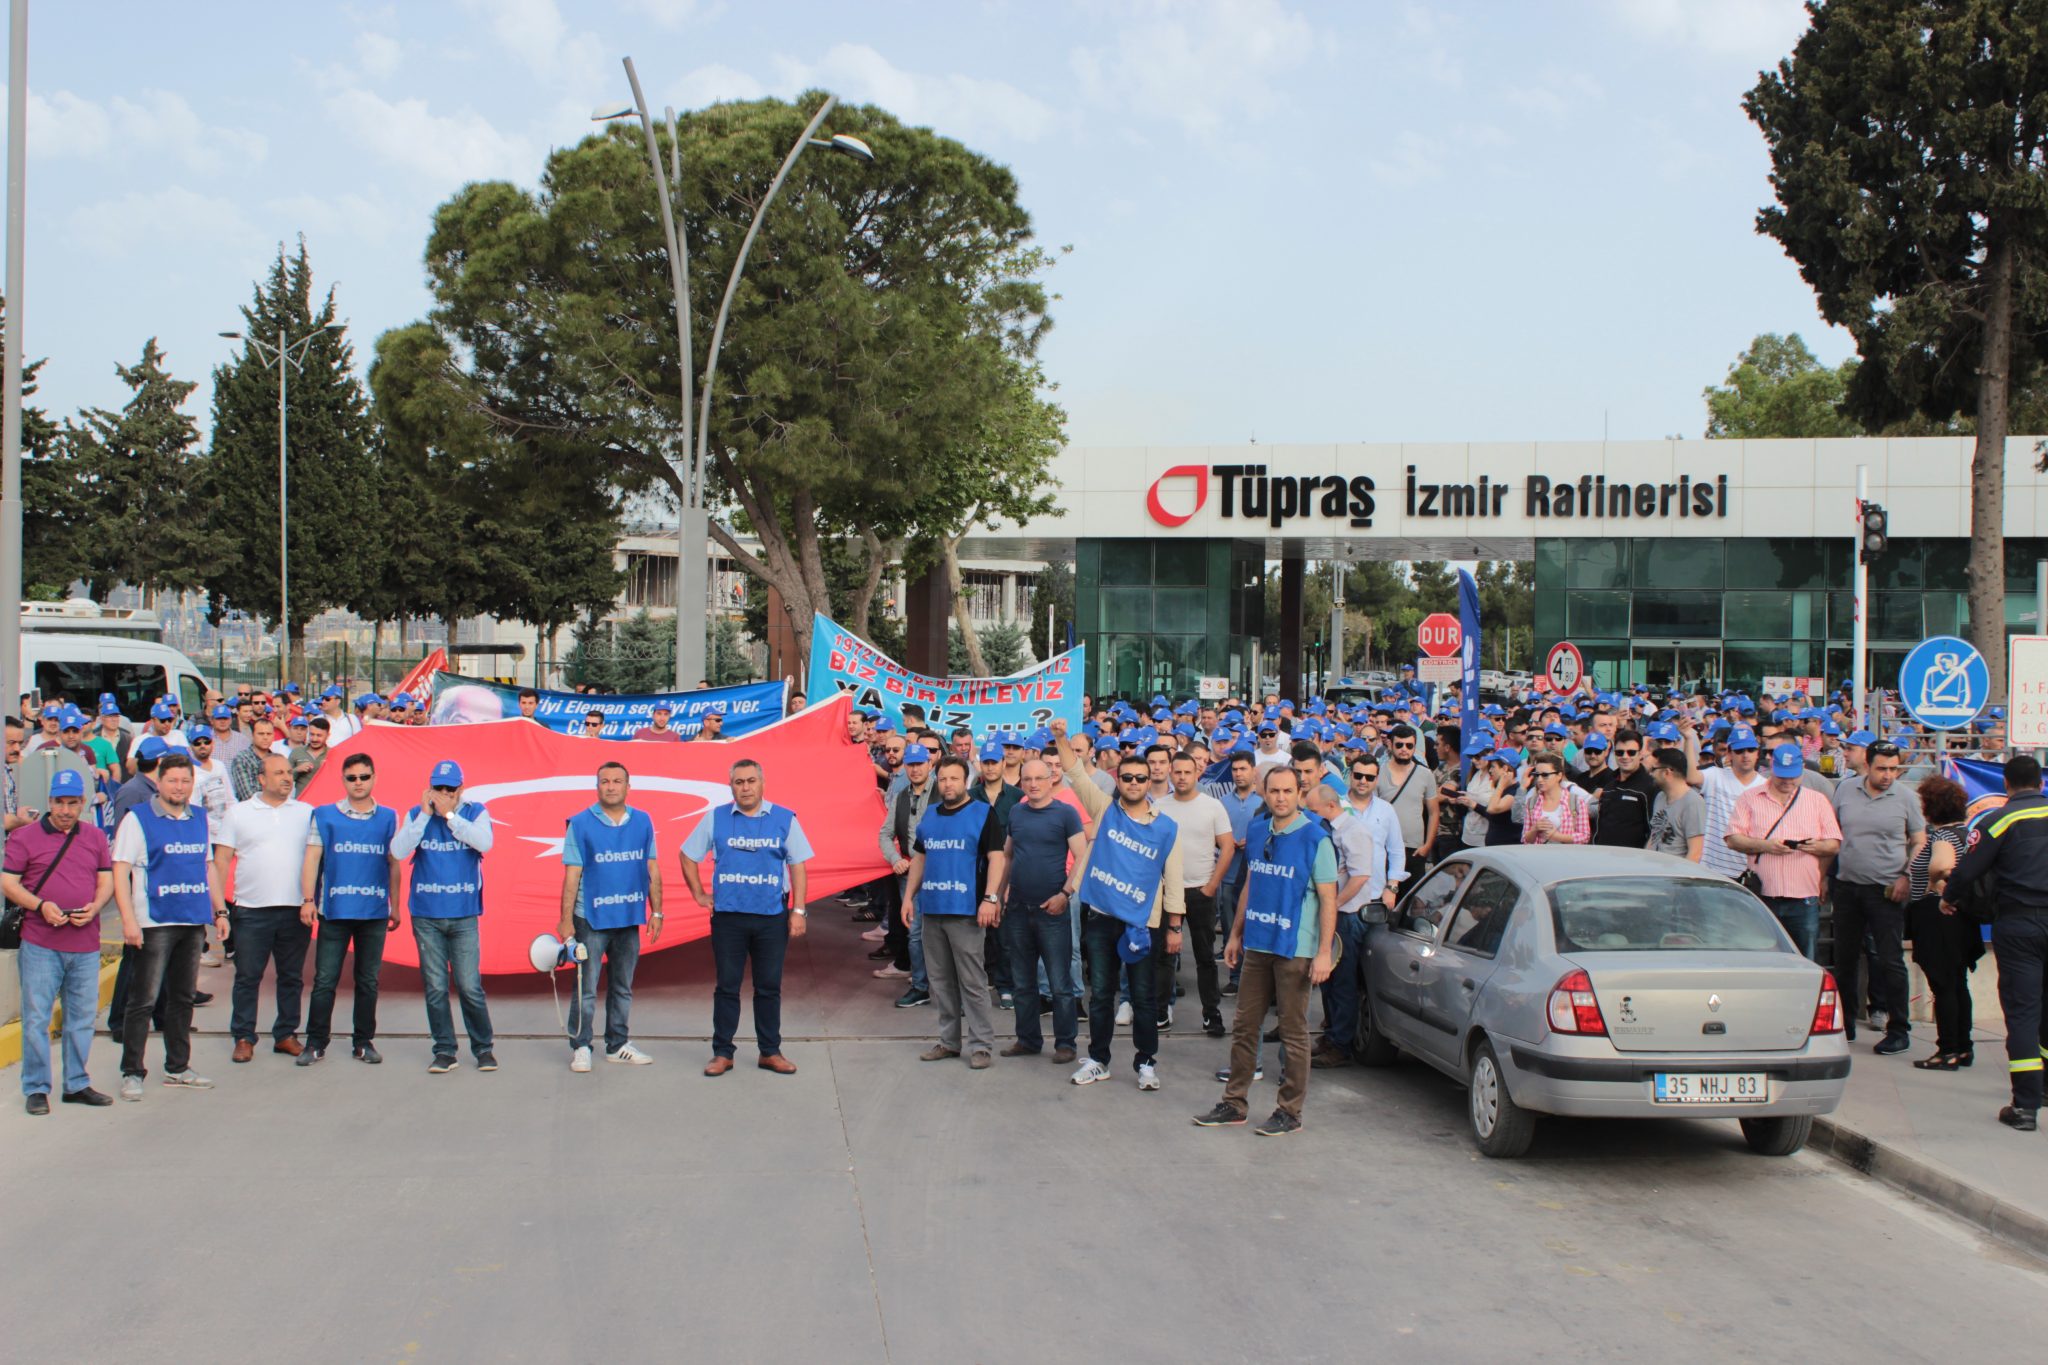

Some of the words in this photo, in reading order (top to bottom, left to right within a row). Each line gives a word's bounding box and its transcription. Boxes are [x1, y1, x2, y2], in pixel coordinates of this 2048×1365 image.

[1212, 464, 1375, 528] Tüpraş
[1406, 464, 1508, 517] İzmir
[1526, 474, 1727, 517] Rafinerisi
[1422, 627, 1458, 645] DUR
[829, 650, 877, 682] BİZ
[1552, 656, 1563, 681] 4
[2038, 682, 2048, 694] F
[564, 700, 625, 715] Eleman
[732, 700, 760, 714] ver.
[2037, 703, 2048, 715] T
[926, 706, 972, 729] İZ
[719, 872, 779, 887] petrol-iş
[1089, 865, 1147, 904] petrol-iş
[1669, 1077, 1688, 1094] 35
[1699, 1077, 1728, 1094] NHJ
[1738, 1076, 1756, 1094] 83
